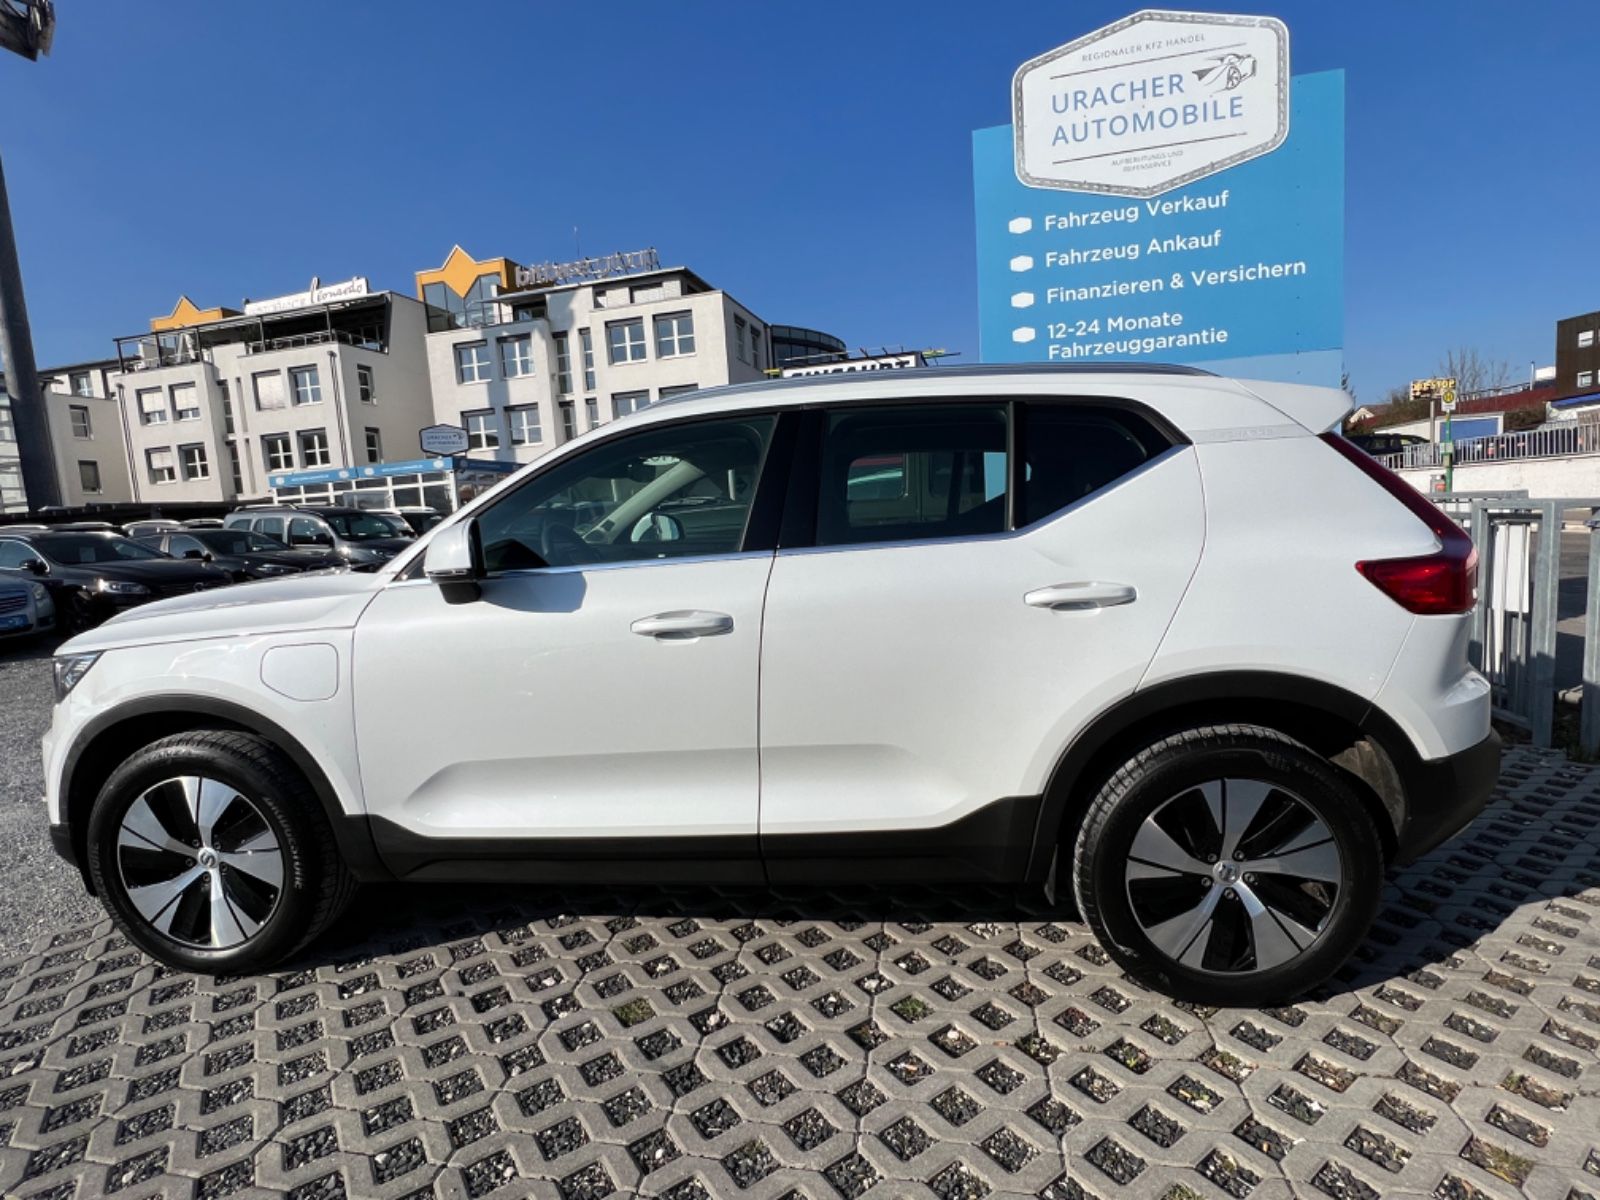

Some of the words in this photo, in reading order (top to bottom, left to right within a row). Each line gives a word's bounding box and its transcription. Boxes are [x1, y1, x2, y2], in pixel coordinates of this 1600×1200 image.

[1081, 44, 1142, 61] REGIONALER
[1145, 40, 1163, 51] KFZ
[1165, 33, 1206, 48] HANDEL
[1051, 74, 1185, 114] URACHER
[1051, 96, 1244, 147] AUTOMOBILE
[1044, 205, 1140, 232] Fahrzeug
[1145, 190, 1230, 217] Verkauf
[1045, 243, 1140, 268] Fahrzeug
[1146, 229, 1222, 255] Ankauf
[1046, 276, 1164, 304] Finanzieren
[1169, 272, 1185, 289] &
[1190, 260, 1307, 287] Versichern
[1047, 319, 1101, 340] 12-24
[1106, 311, 1184, 333] Monate
[1048, 327, 1229, 361] Fahrzeuggarantie
